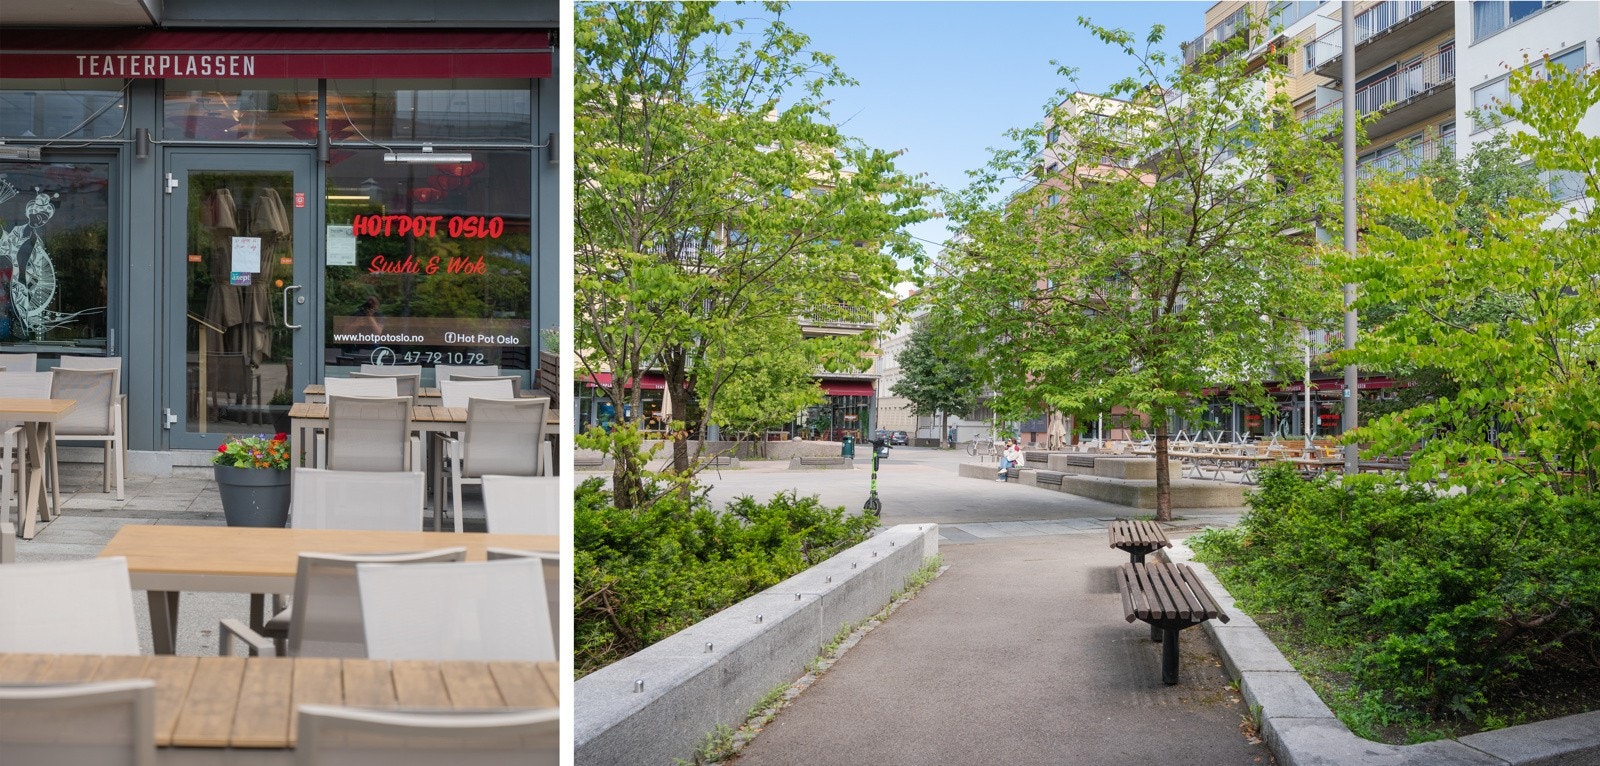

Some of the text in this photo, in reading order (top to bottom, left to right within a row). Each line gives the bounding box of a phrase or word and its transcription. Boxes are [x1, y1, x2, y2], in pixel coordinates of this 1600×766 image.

[76, 55, 255, 76] TEATERPLASSEN
[352, 214, 504, 239] HOTPOT OSLO
[368, 255, 487, 275] Sushi & Wok
[333, 332, 424, 344] www.hotpotoslo.no
[457, 333, 475, 344] Hot
[477, 334, 495, 345] Pot
[497, 334, 520, 345] Oslo
[403, 351, 484, 365] 47 72 10 72
